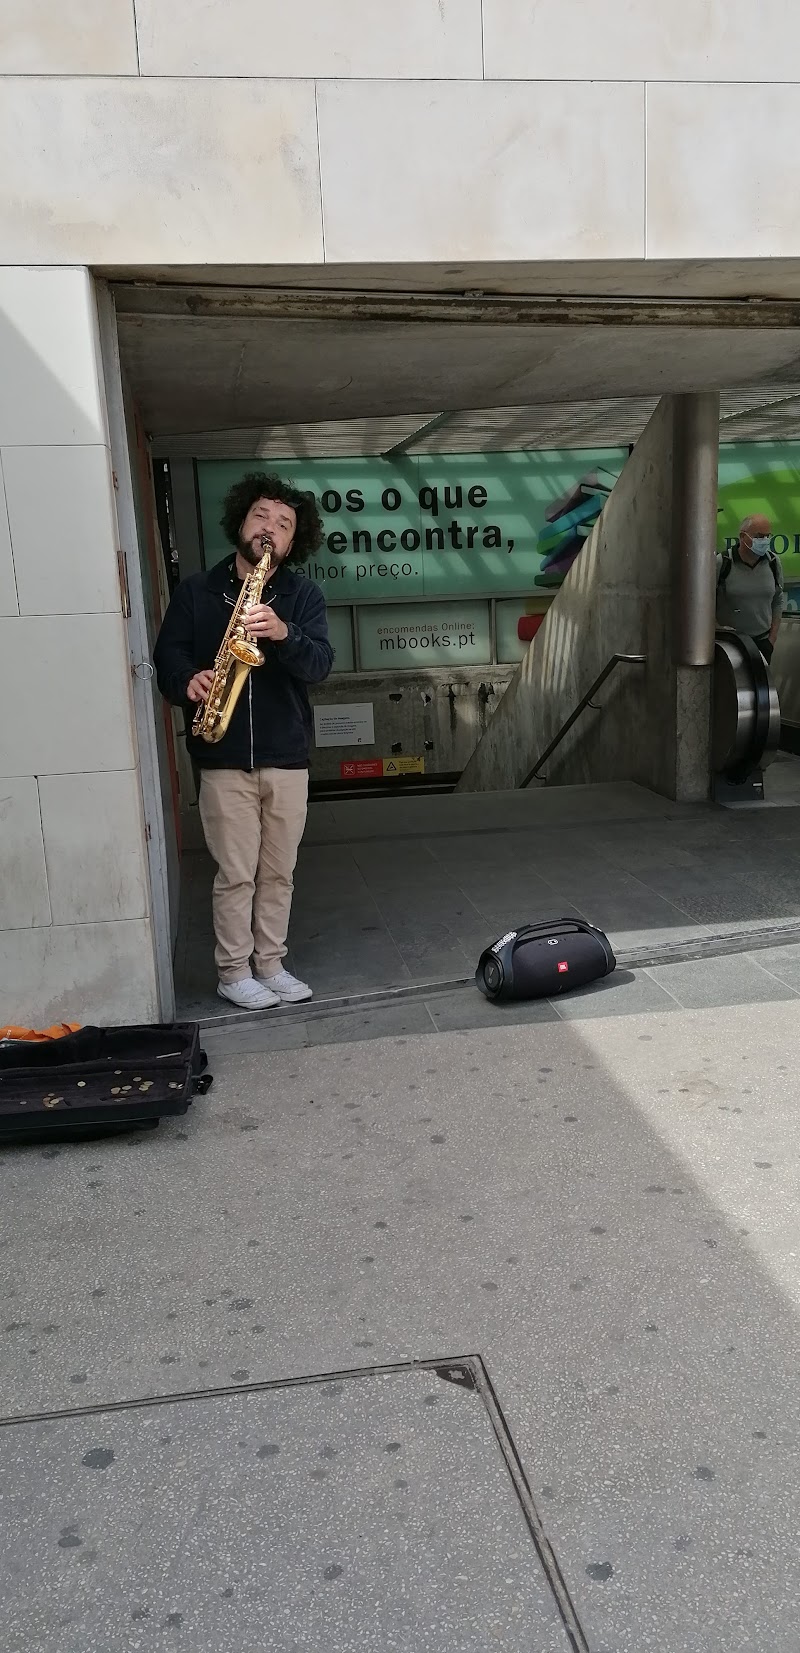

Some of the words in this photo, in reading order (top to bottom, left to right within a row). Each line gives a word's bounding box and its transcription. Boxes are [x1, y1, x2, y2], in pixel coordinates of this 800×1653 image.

[303, 488, 365, 513] os
[381, 487, 402, 512] o
[419, 485, 488, 516] que
[327, 520, 515, 554] encontra,
[294, 562, 347, 580] elhor
[356, 560, 419, 581] preço.
[377, 624, 438, 635] encomendas
[441, 621, 475, 632] Online:
[379, 631, 476, 651] mbooks.pt
